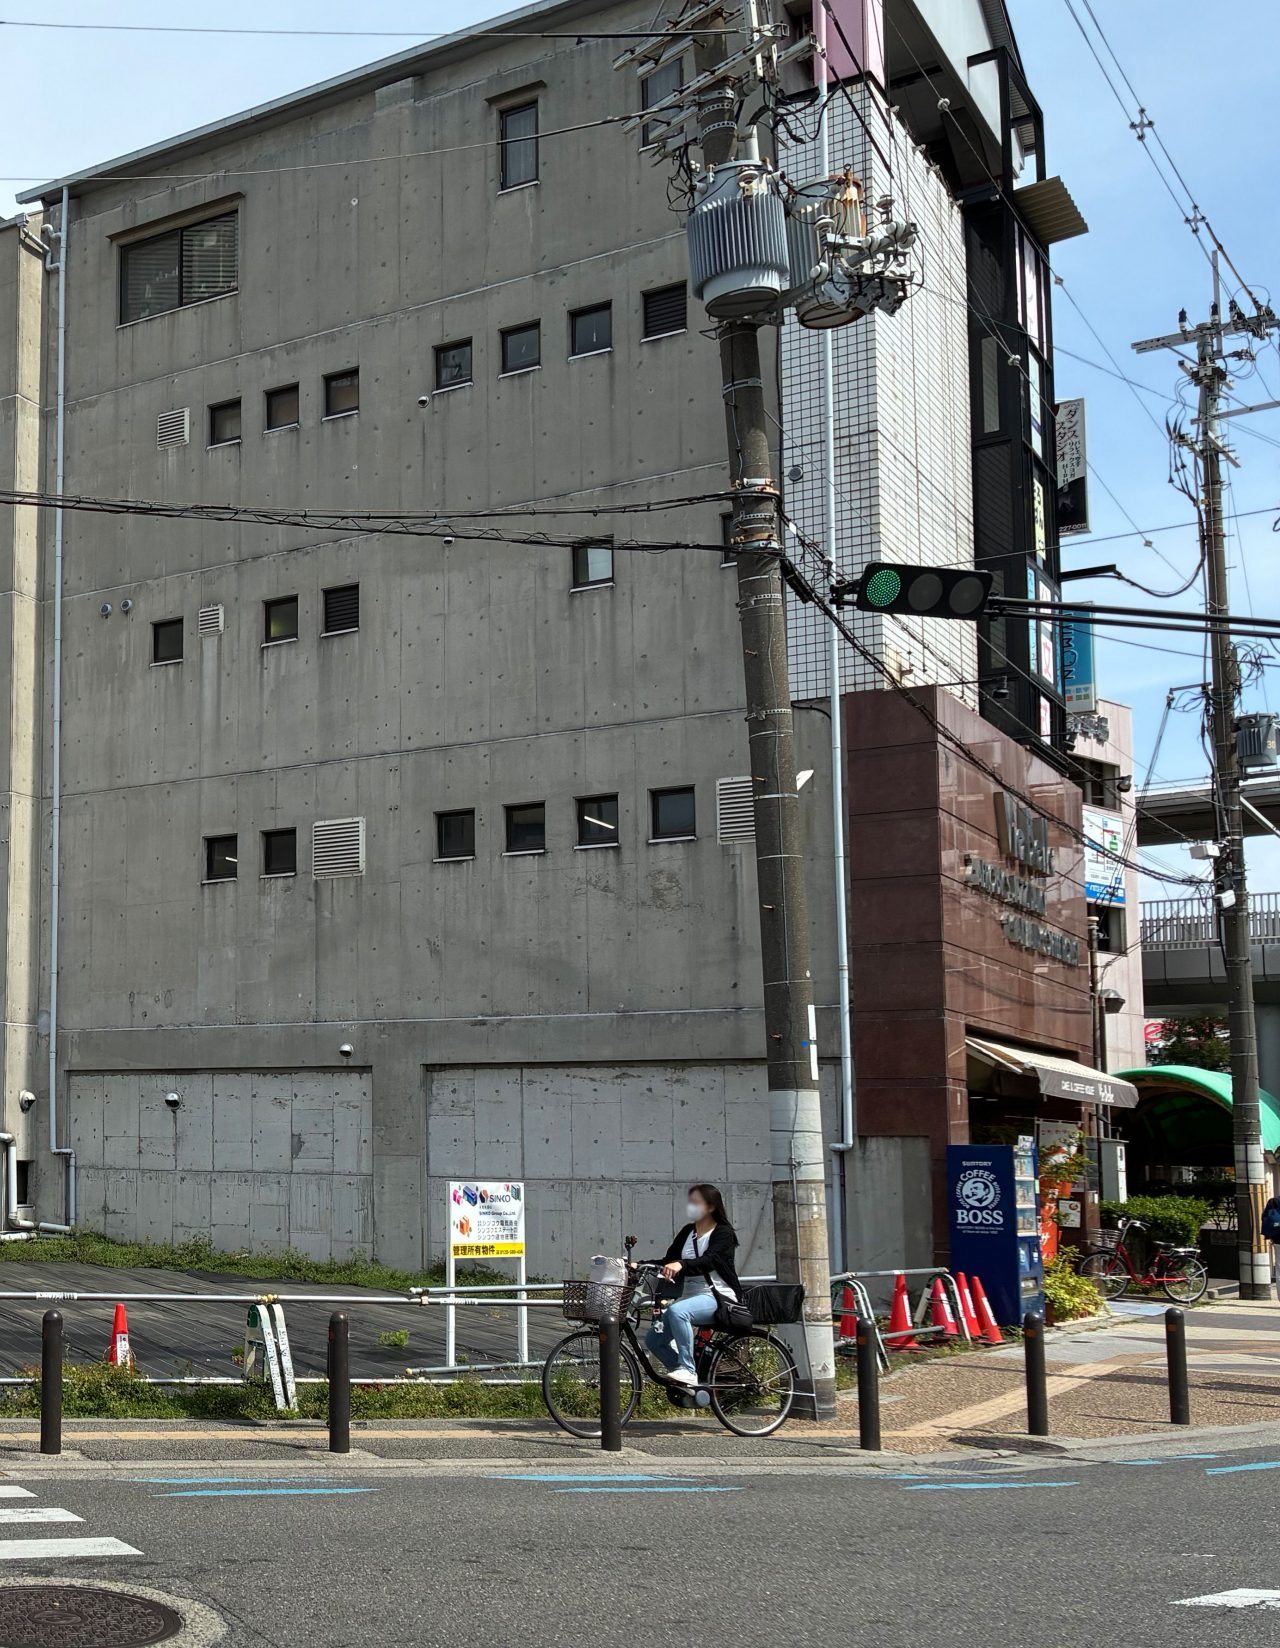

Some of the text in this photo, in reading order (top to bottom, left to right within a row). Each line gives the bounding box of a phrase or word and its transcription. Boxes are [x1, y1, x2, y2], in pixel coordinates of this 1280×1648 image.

[1065, 406, 1079, 438] ダンス
[960, 1169, 997, 1182] COFFEE
[489, 1194, 510, 1202] SINKO
[955, 1209, 1004, 1225] BOSS
